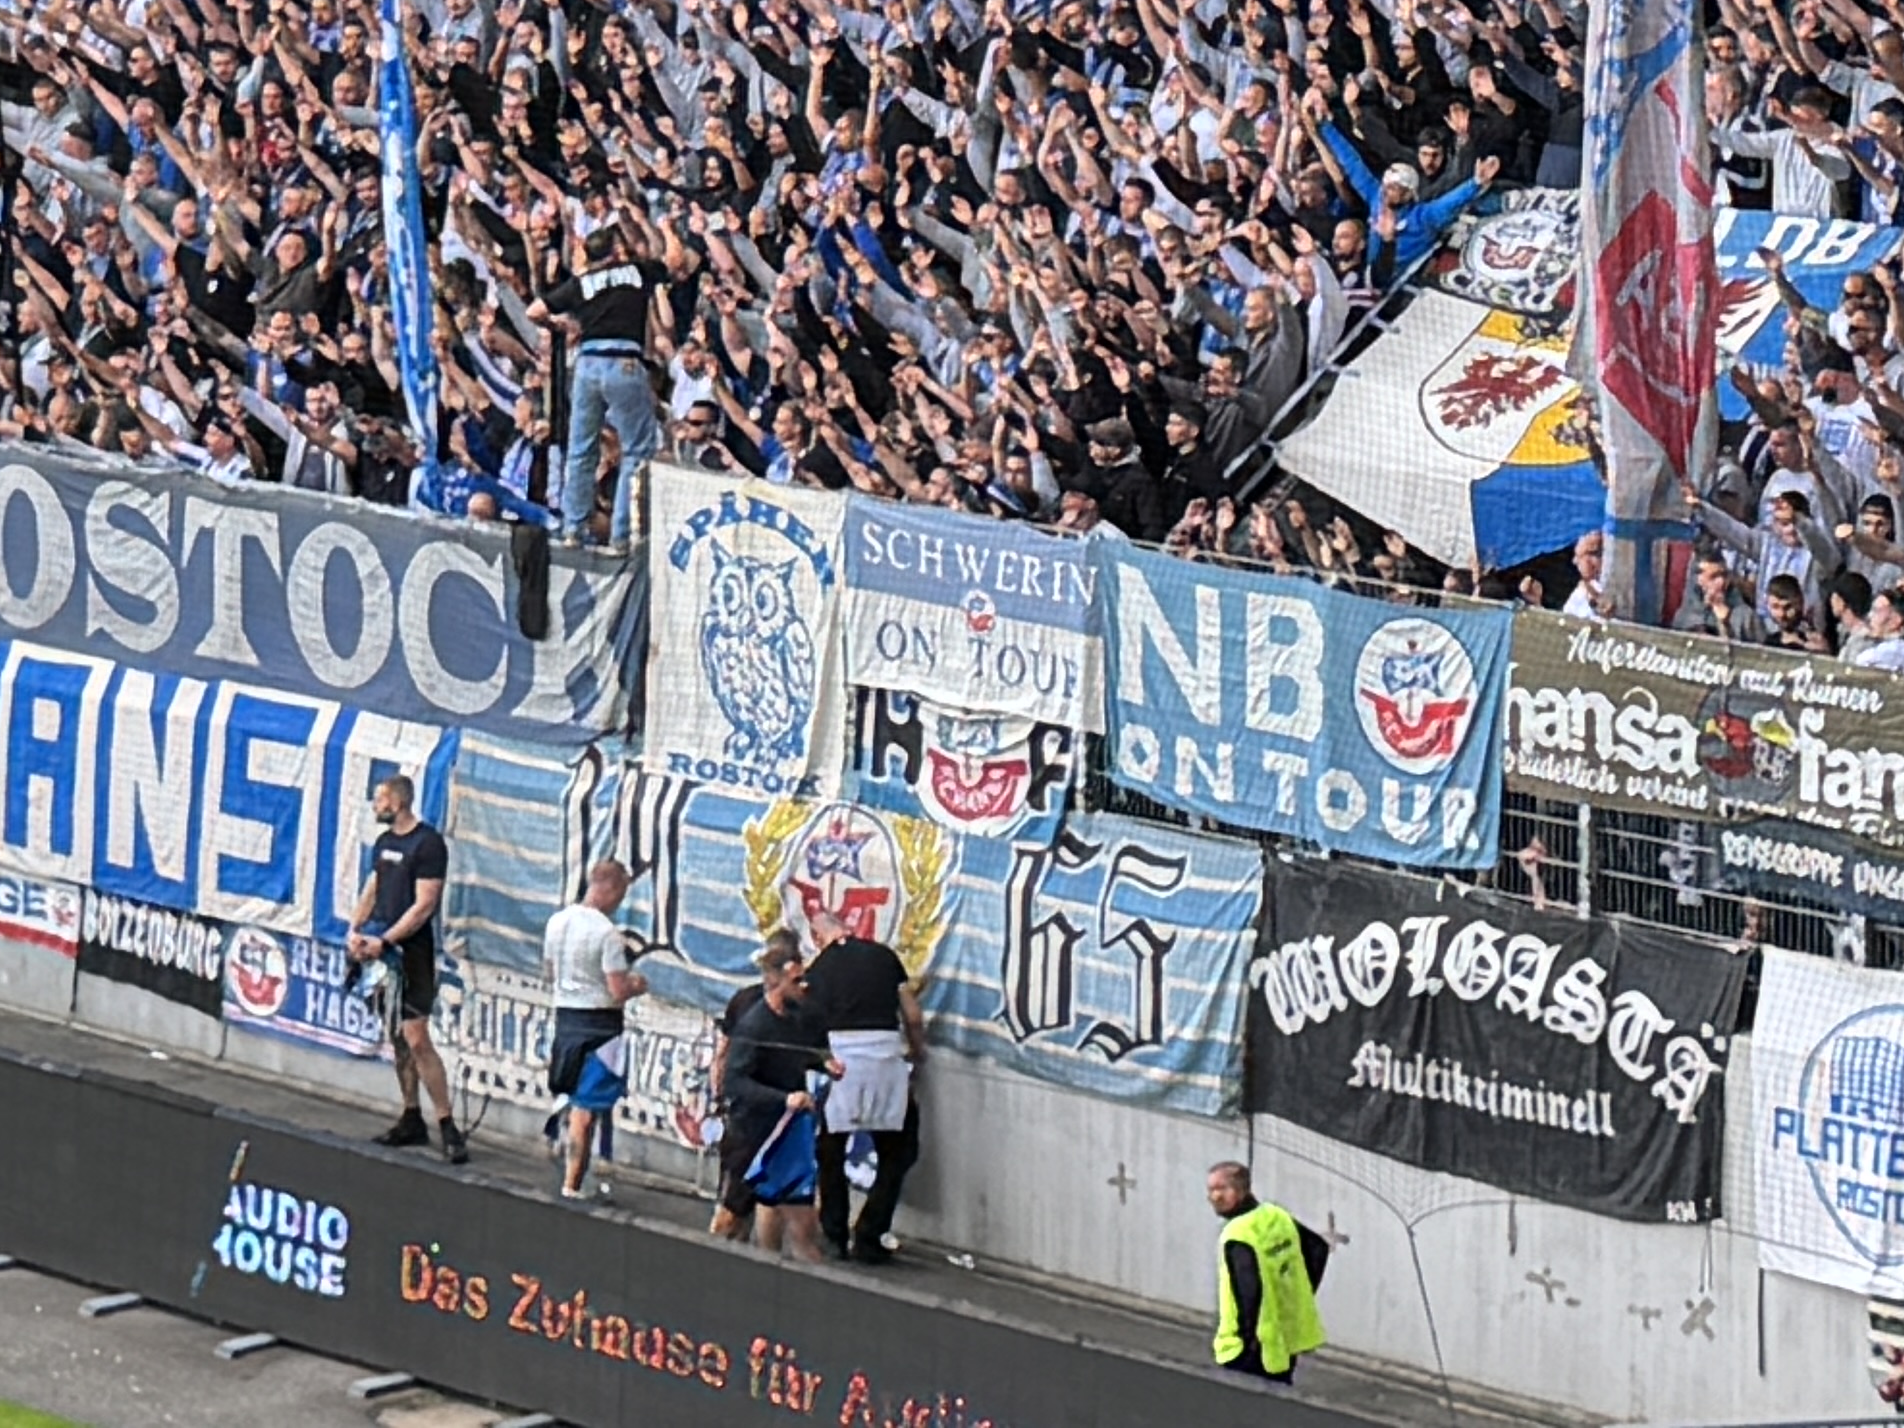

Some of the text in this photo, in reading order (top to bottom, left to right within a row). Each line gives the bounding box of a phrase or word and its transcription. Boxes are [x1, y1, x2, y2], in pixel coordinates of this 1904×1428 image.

[862, 520, 1100, 607] SCHWERIN
[876, 621, 936, 671] ON
[1117, 562, 1325, 743] NB
[1505, 662, 1701, 778] hansa
[667, 753, 821, 797] ROSTOCK
[1117, 722, 1235, 804] ON
[1262, 749, 1480, 850] TOUR
[83, 886, 222, 981] BOIZENBURG
[994, 828, 1188, 1063] 65
[1347, 1040, 1616, 1138] Multikriminell
[222, 1182, 350, 1252] AUDIO
[401, 1243, 489, 1320] Das
[748, 1335, 824, 1418] für
